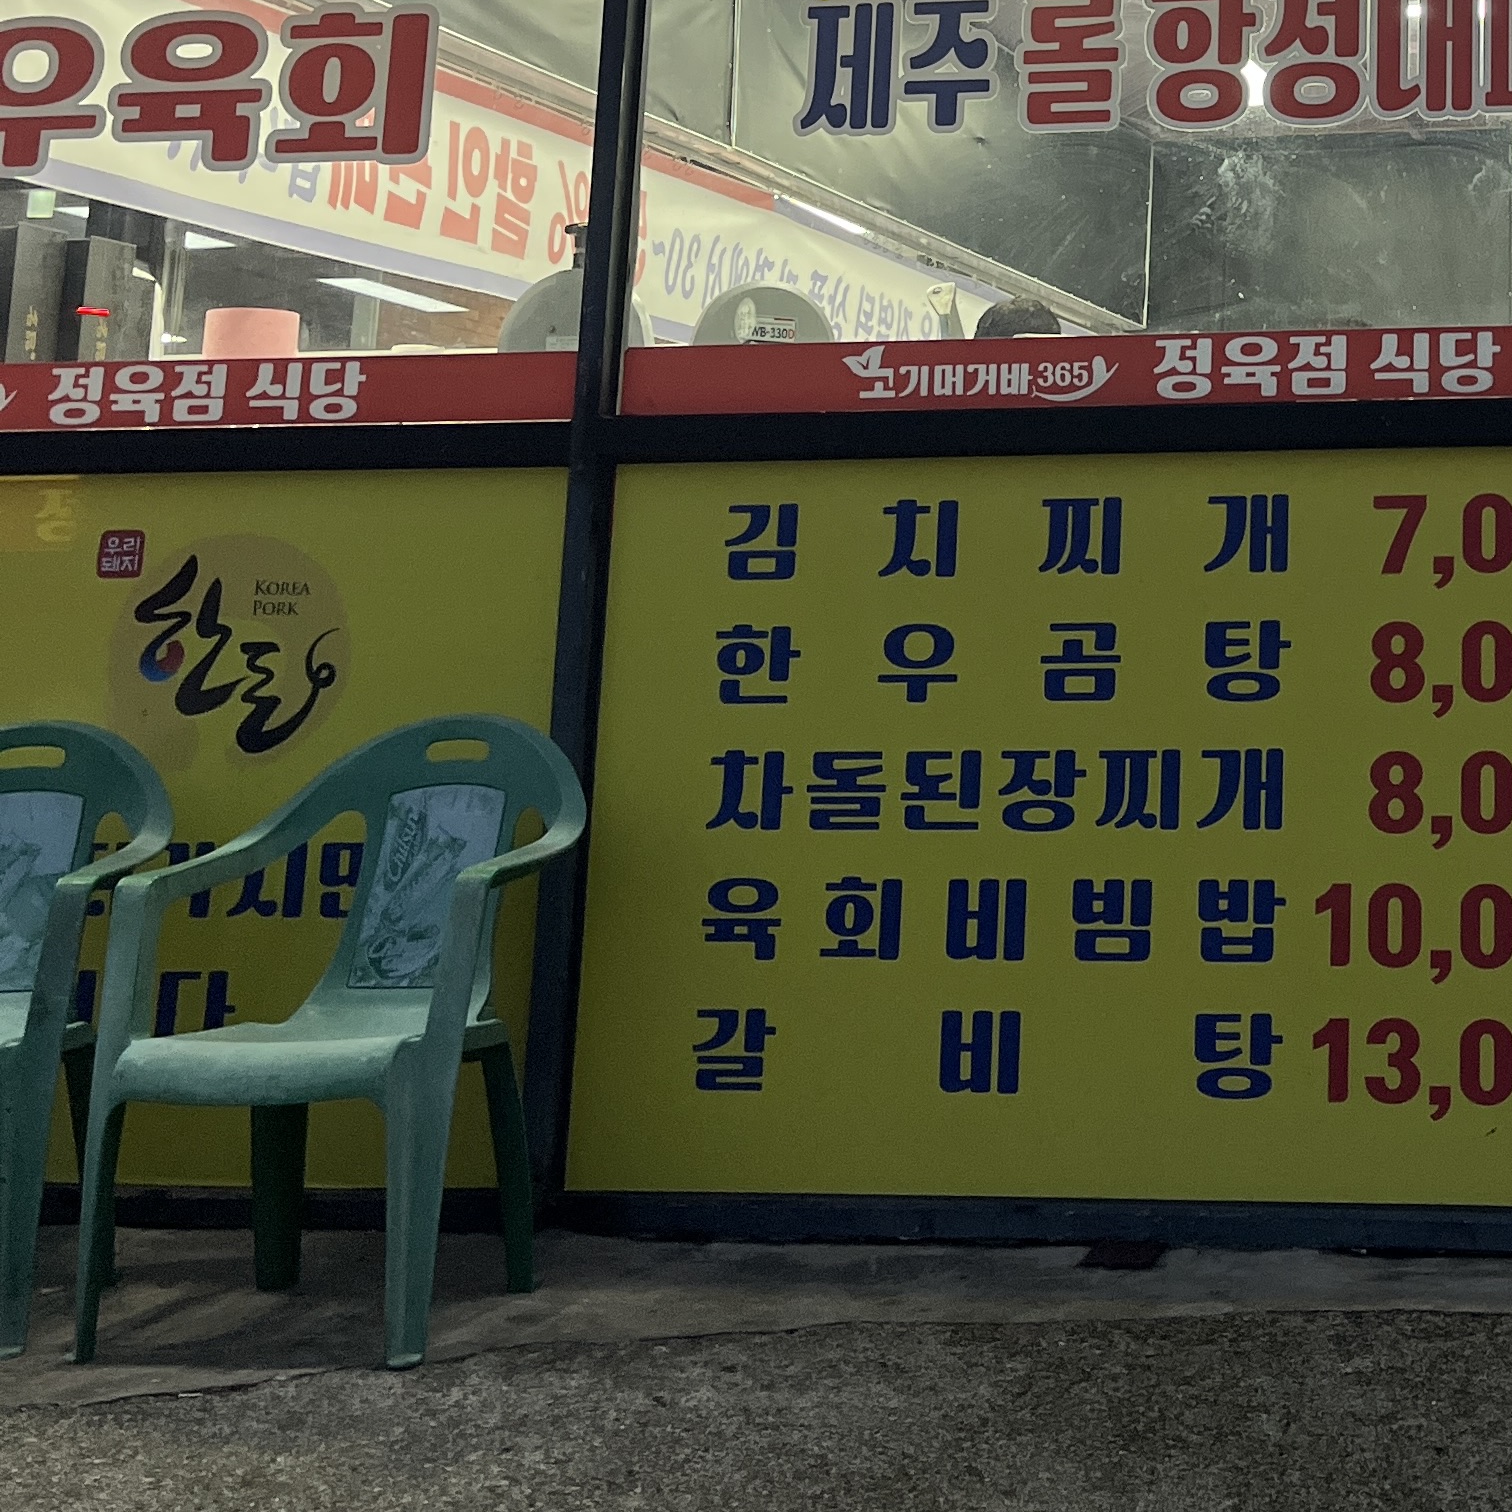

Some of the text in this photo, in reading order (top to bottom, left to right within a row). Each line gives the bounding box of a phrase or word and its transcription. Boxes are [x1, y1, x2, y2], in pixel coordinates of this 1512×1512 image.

[0, 7, 436, 172] 우육회
[48, 361, 366, 424] 정육점 식당
[1153, 334, 1347, 399] 정육점
[1370, 331, 1501, 393] 식당
[103, 535, 141, 555] 우리
[704, 748, 1285, 833] 차돌된장찌개
